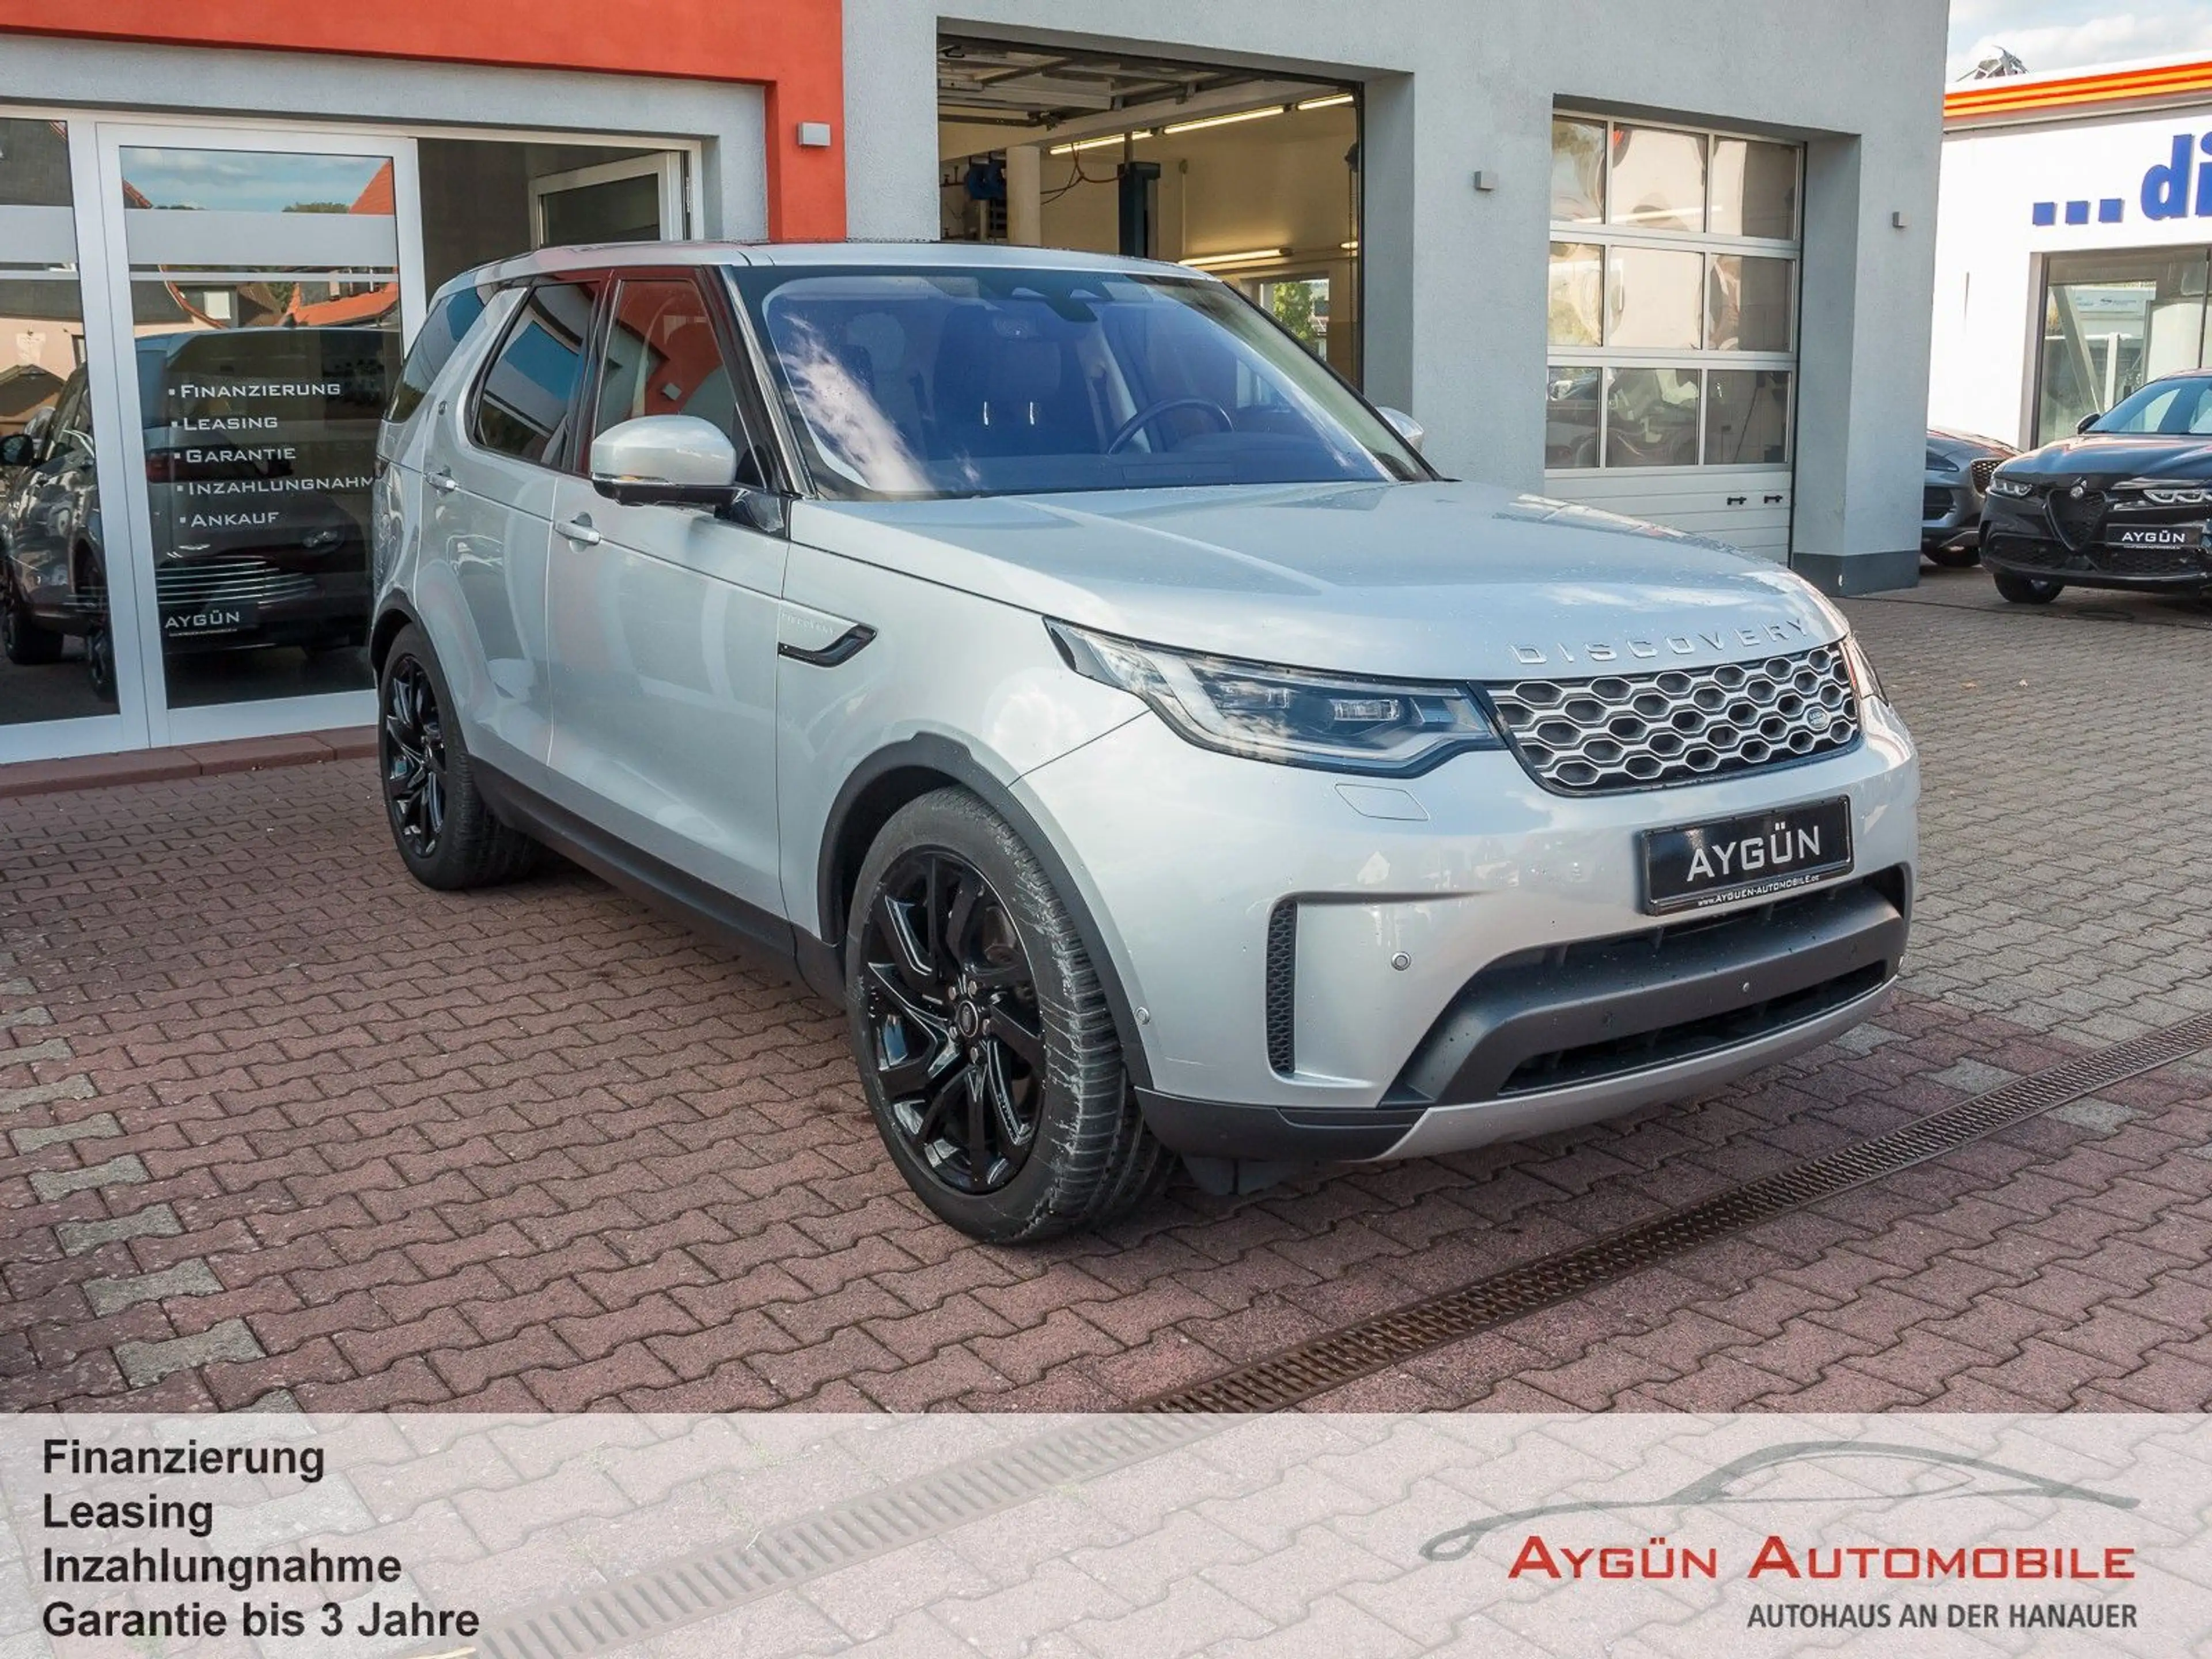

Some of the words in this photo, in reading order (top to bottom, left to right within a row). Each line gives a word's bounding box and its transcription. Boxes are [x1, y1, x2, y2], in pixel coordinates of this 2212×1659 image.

[181, 384, 340, 398] FINANZIERUNG
[184, 418, 278, 430] LEASING
[187, 448, 296, 462] GARANTIE
[191, 512, 279, 528] ANKAUF
[2122, 530, 2185, 543] AYGÜN
[165, 609, 240, 628] AYGÜN
[1509, 618, 1808, 664] DISCOVERY
[1687, 822, 1820, 881] AYGÜN
